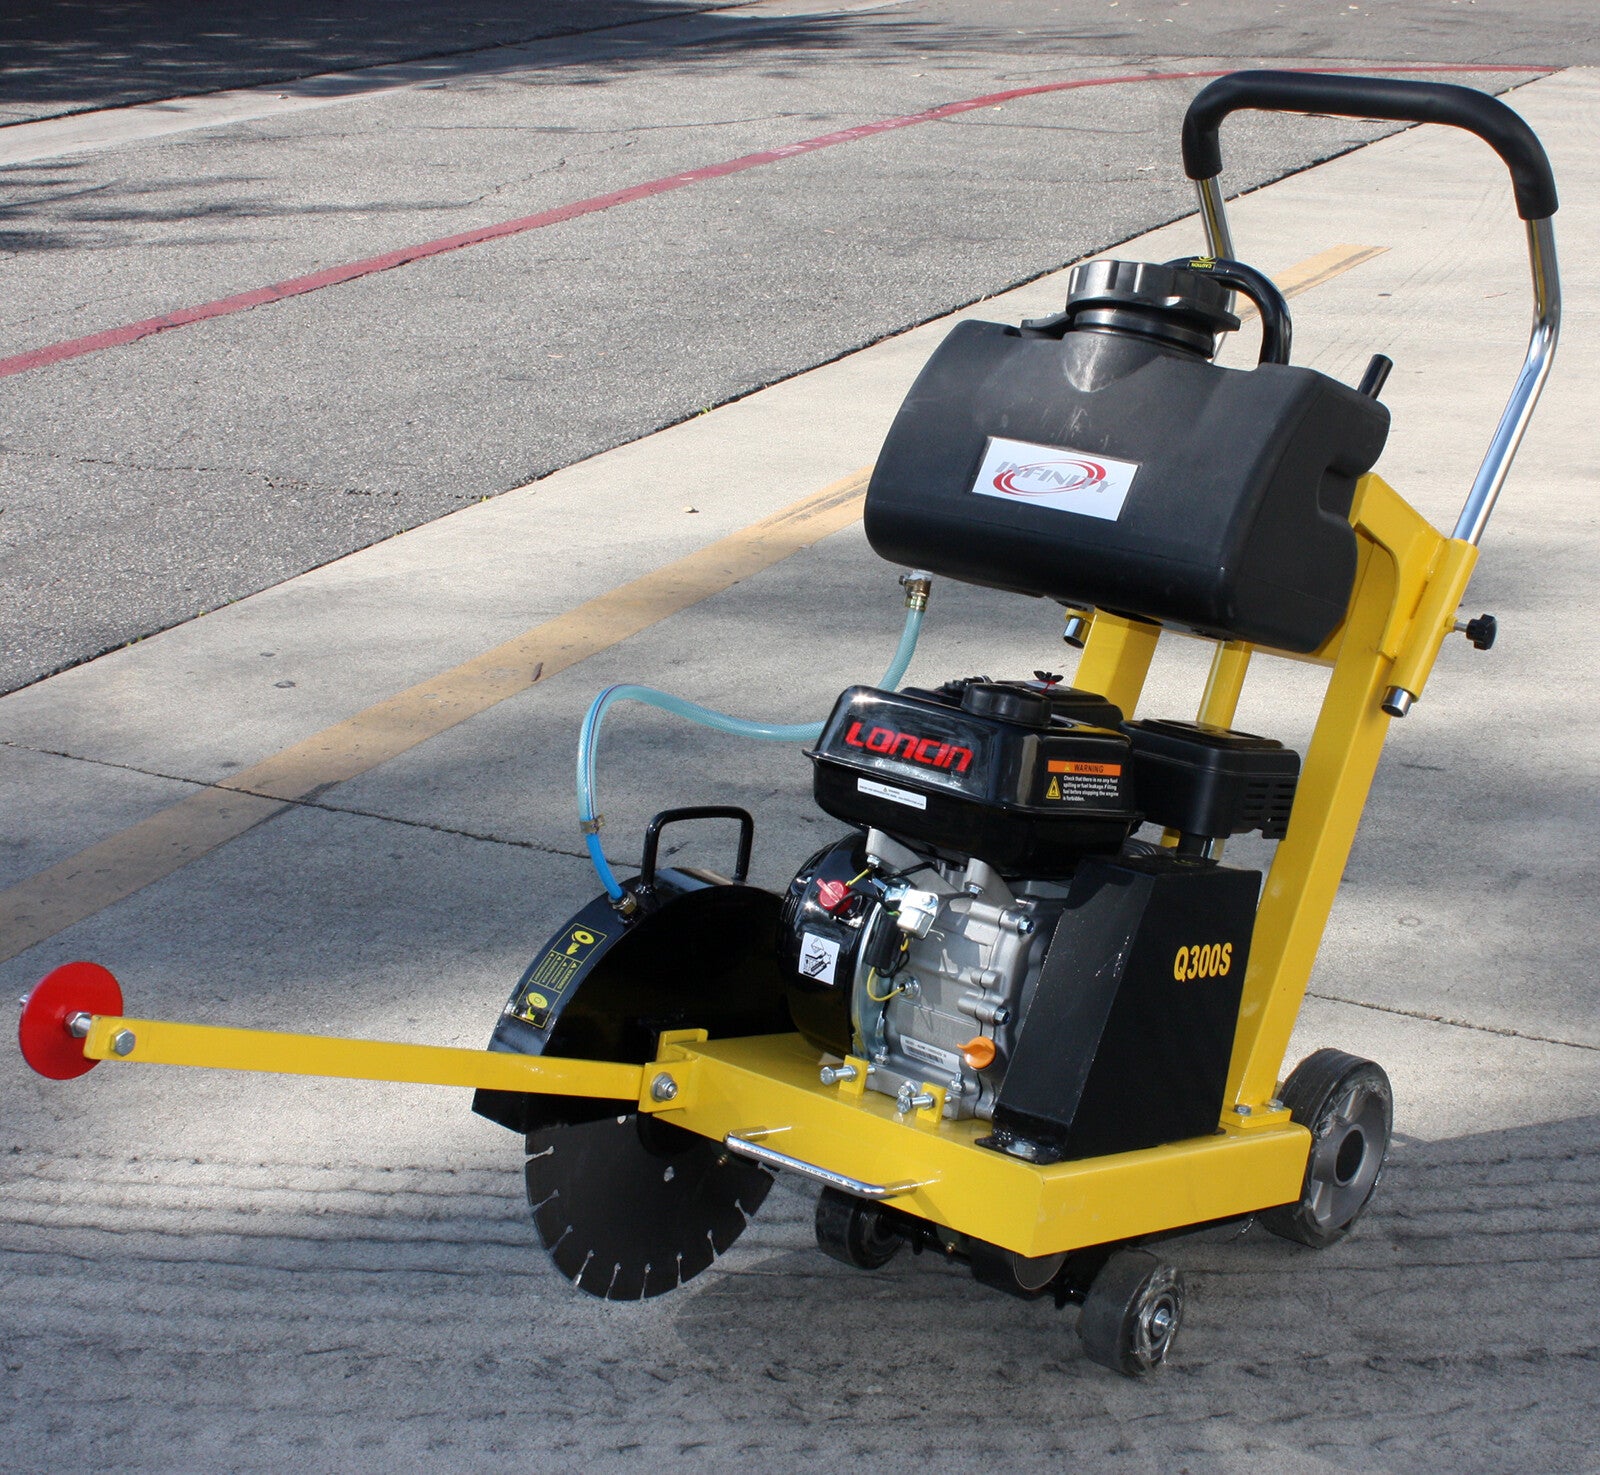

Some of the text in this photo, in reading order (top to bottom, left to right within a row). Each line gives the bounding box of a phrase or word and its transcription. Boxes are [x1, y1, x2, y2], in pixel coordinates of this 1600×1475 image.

[995, 461, 1119, 494] INFINITY
[1074, 763, 1104, 773] WARNING
[1174, 942, 1232, 982] Q300S
